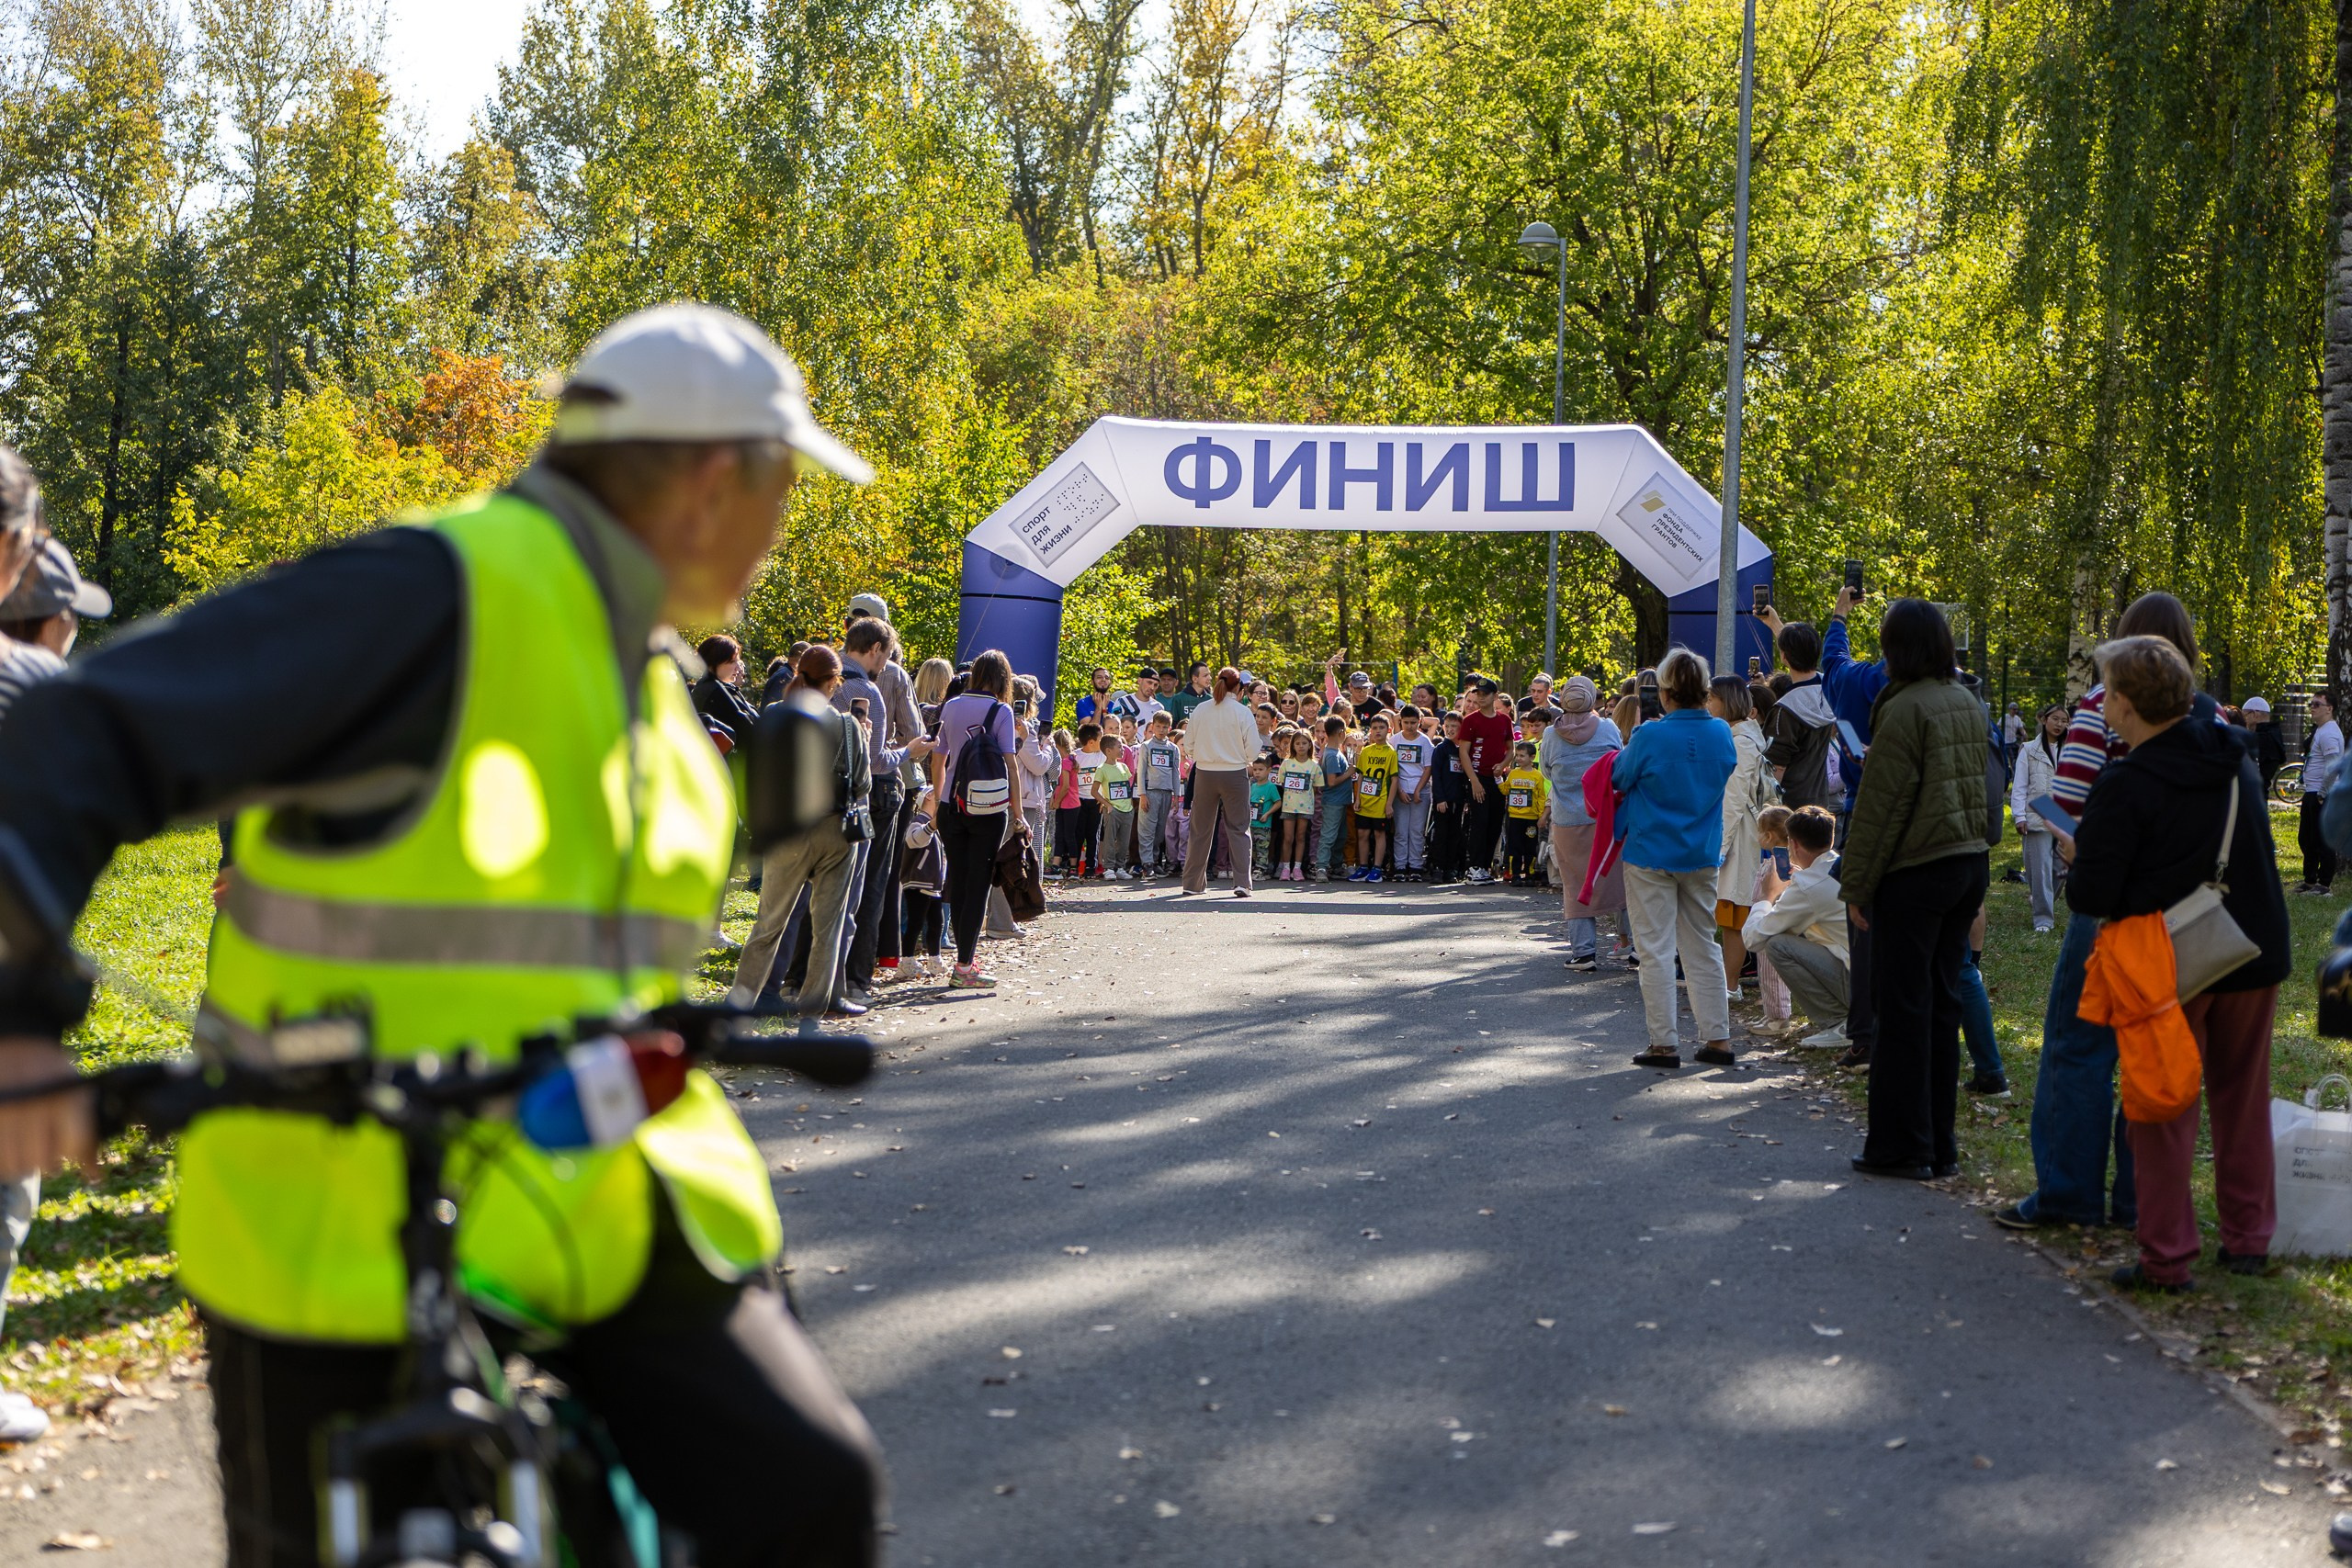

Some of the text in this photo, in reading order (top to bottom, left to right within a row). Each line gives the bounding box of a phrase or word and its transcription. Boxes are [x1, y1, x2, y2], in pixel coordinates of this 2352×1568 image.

[1163, 436, 1576, 512] ФИНИШ
[1662, 513, 1683, 534] ФОНДА
[1667, 507, 1702, 541] ПРИ ПОДДЕРЖКЕ
[1651, 524, 1678, 548] ГРАНТОВ
[1657, 518, 1703, 562] ПРЕЗИДЕНТСКИХ
[1368, 756, 1386, 765] ХУЗИН
[1114, 790, 1125, 798] 72
[1289, 780, 1300, 788] 26
